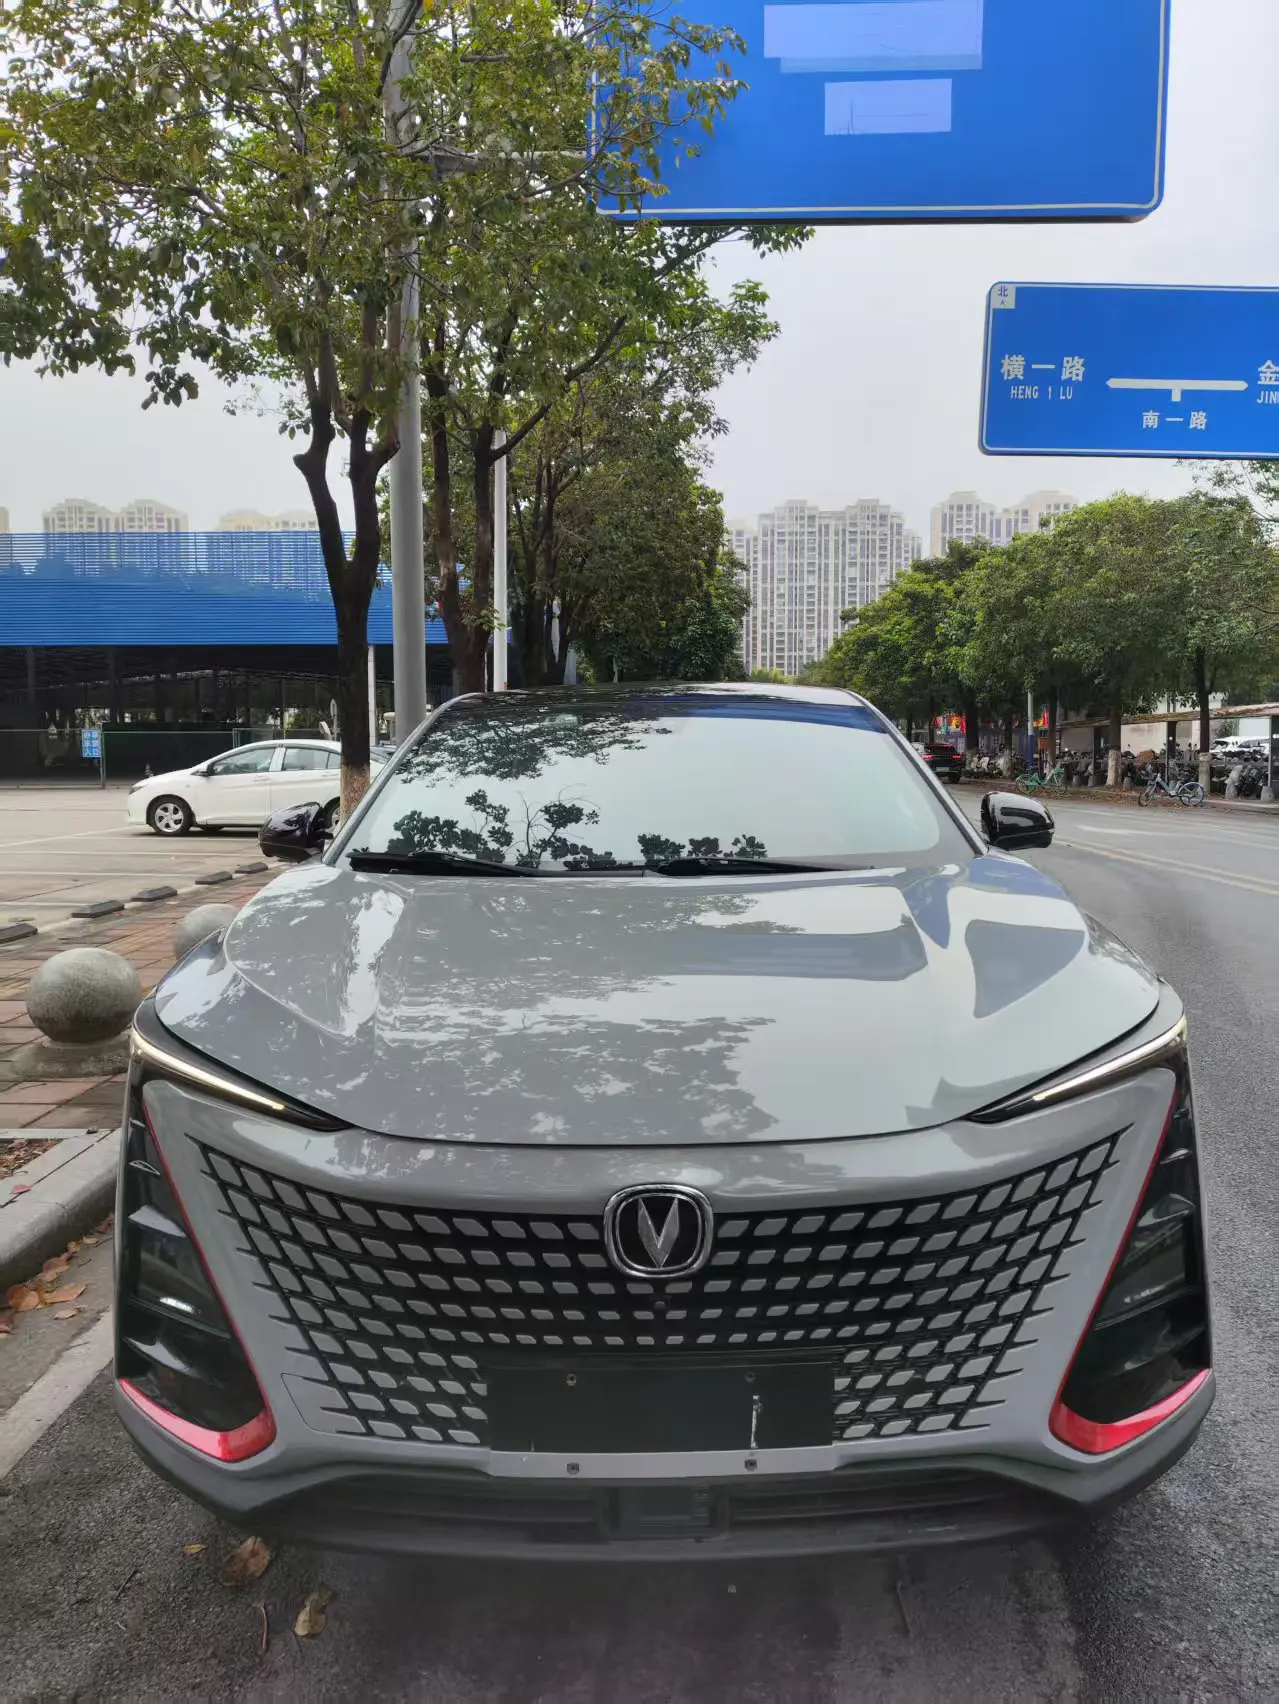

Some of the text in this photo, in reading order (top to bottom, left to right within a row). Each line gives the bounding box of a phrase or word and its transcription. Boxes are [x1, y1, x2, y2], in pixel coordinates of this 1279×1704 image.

[997, 285, 1008, 298] 北
[1001, 354, 1085, 381] 横一路
[1257, 359, 1279, 385] 金
[1010, 385, 1039, 399] HENG
[1060, 385, 1073, 400] LU
[1142, 410, 1207, 430] 南一路
